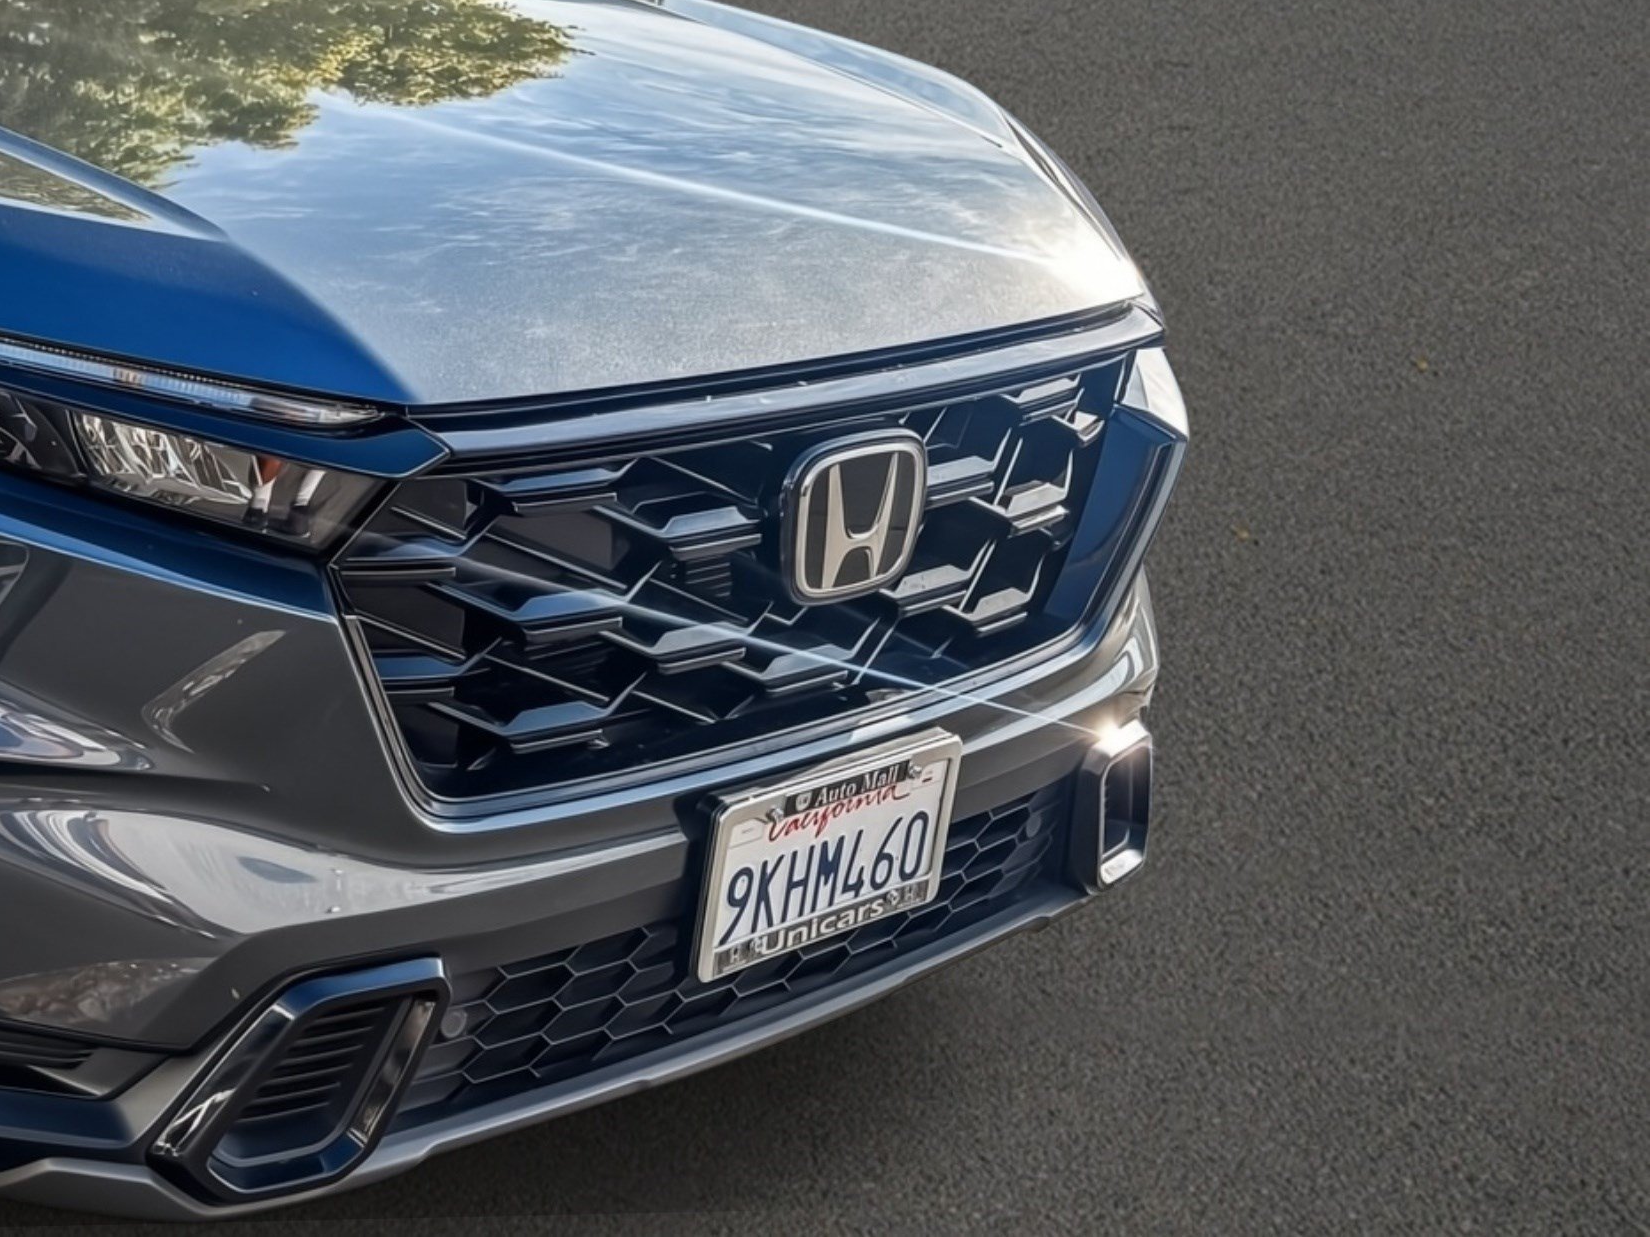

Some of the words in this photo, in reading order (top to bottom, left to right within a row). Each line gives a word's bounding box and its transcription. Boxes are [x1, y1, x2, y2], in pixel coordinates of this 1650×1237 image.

[813, 781, 857, 808] Auto
[860, 764, 901, 793] Mall
[718, 810, 930, 947] 9KHM460
[761, 899, 885, 955] Unicars
